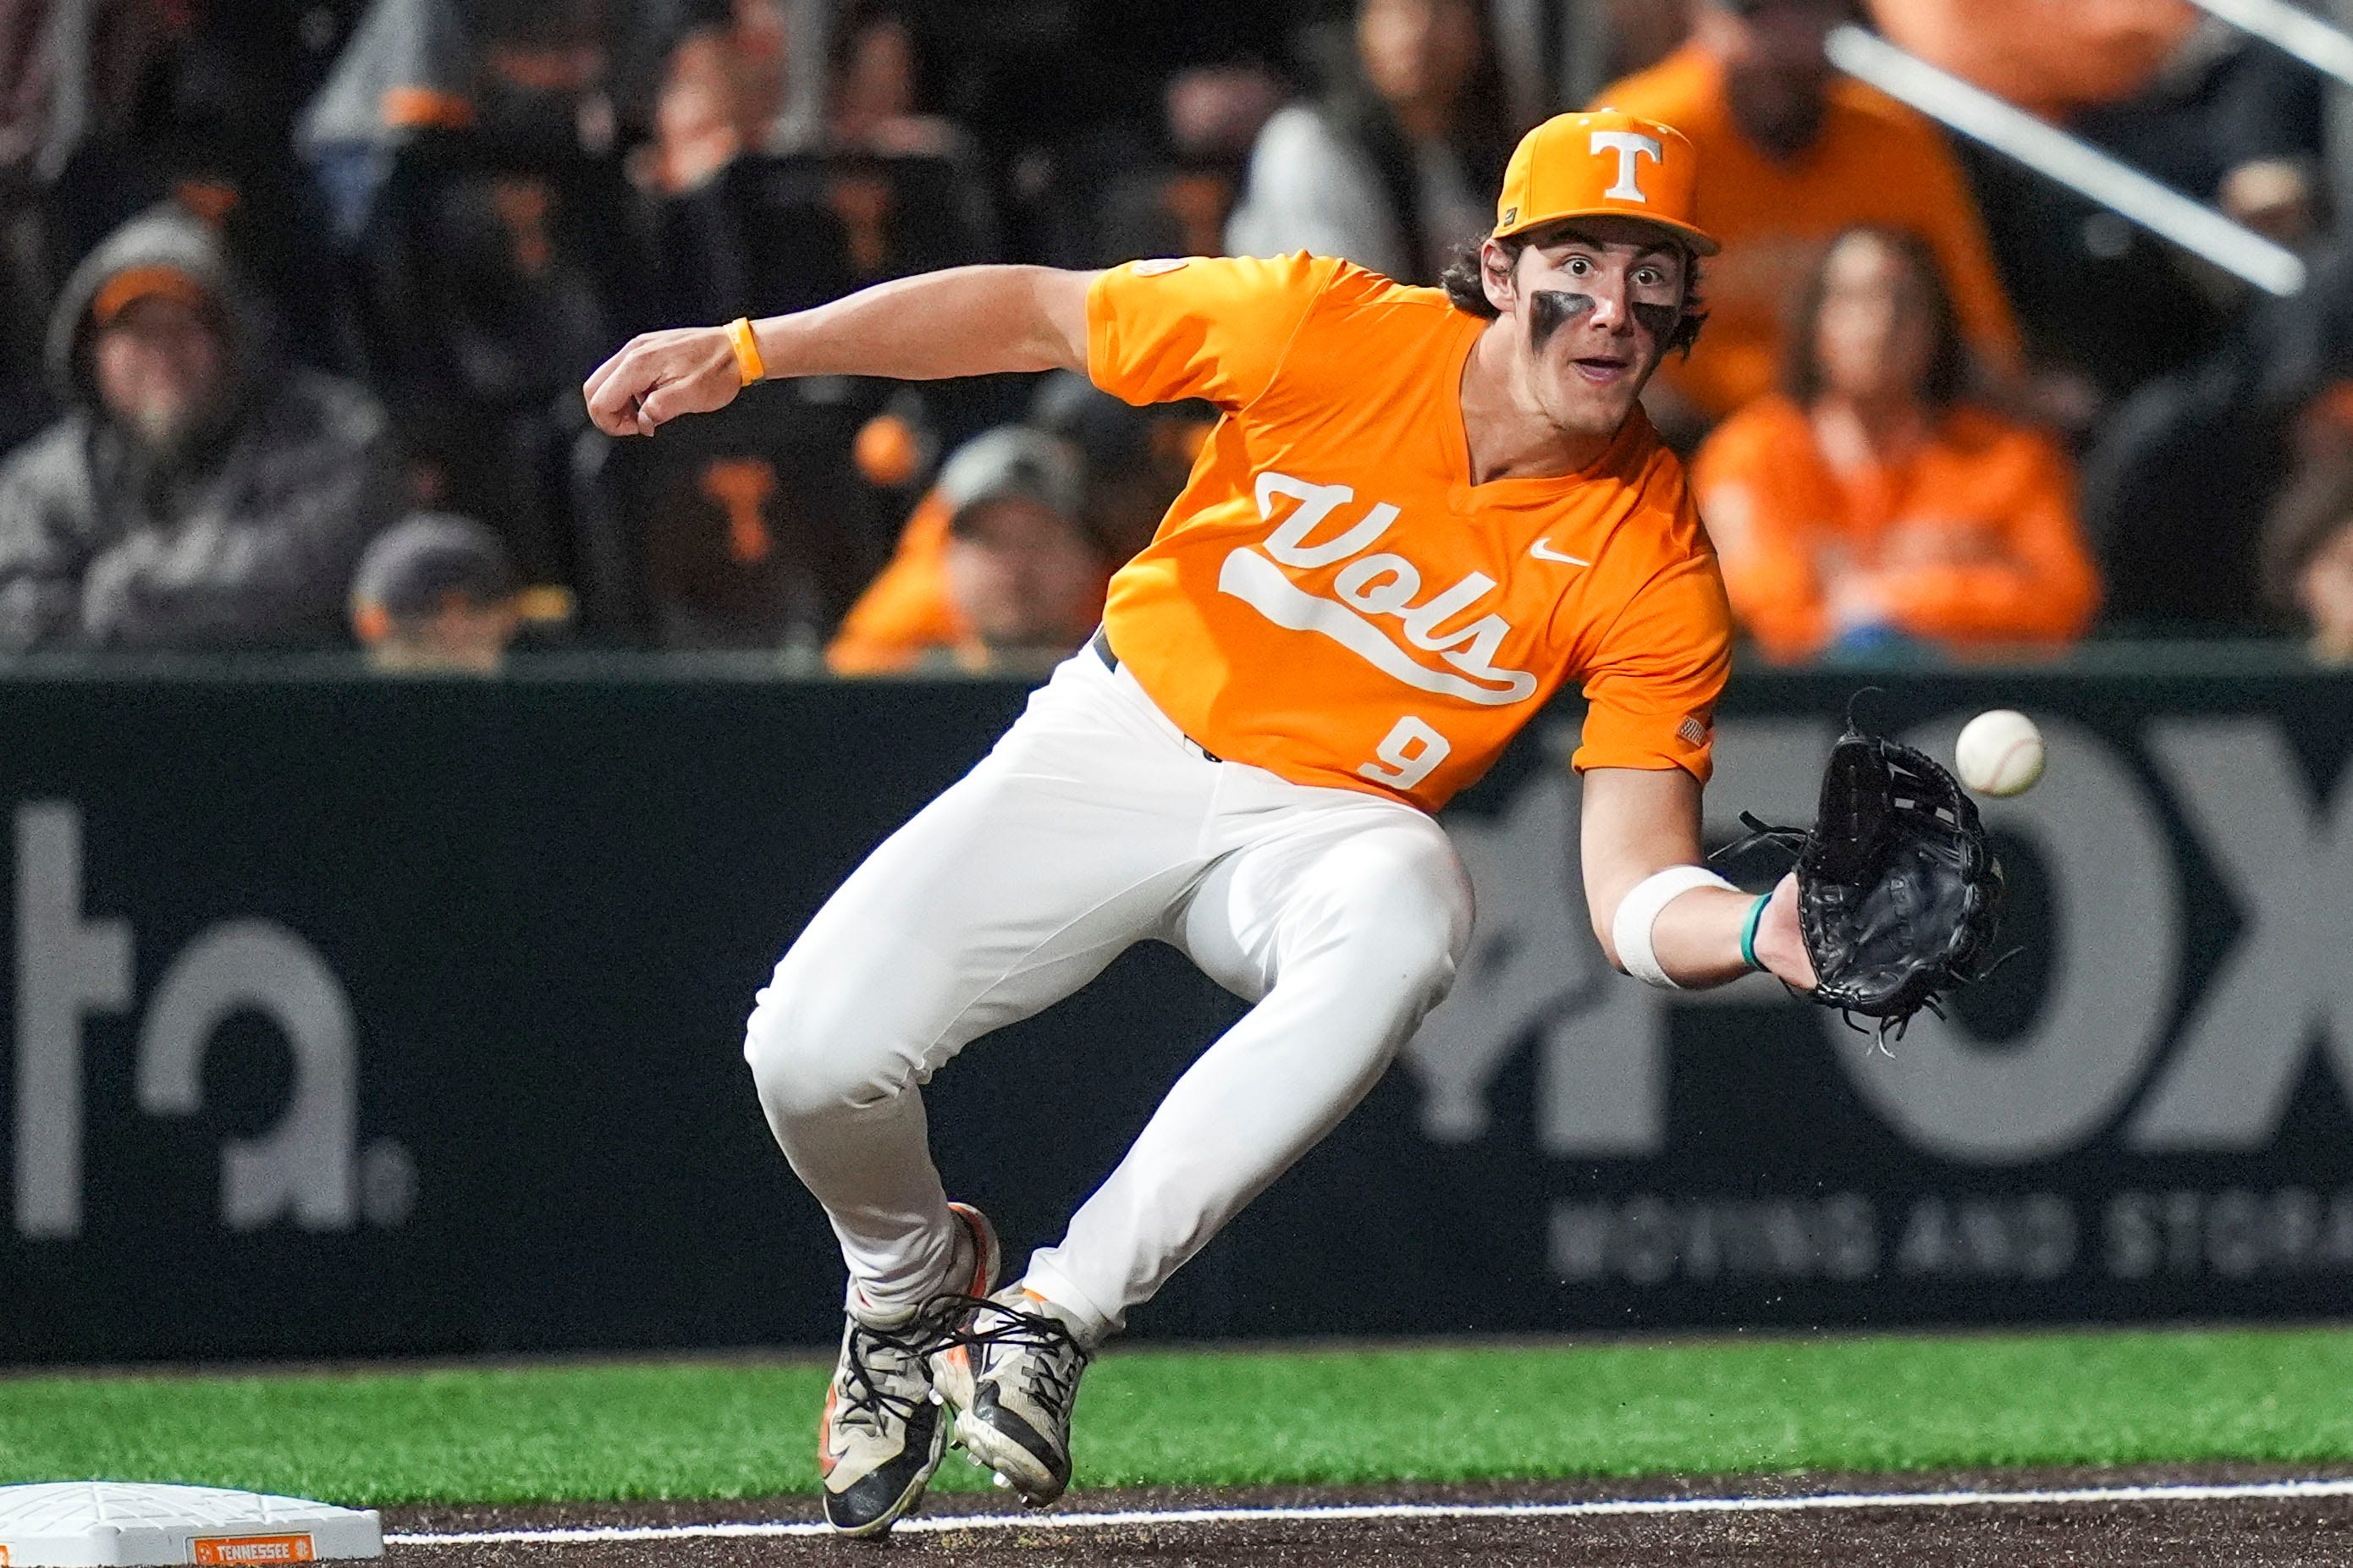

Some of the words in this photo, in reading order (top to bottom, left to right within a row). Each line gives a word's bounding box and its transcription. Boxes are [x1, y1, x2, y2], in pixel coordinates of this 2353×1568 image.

[1590, 131, 1661, 203] T
[1254, 470, 1524, 687] Vols
[1356, 715, 1452, 790] 9
[217, 1543, 289, 1561] TENNESSEE
